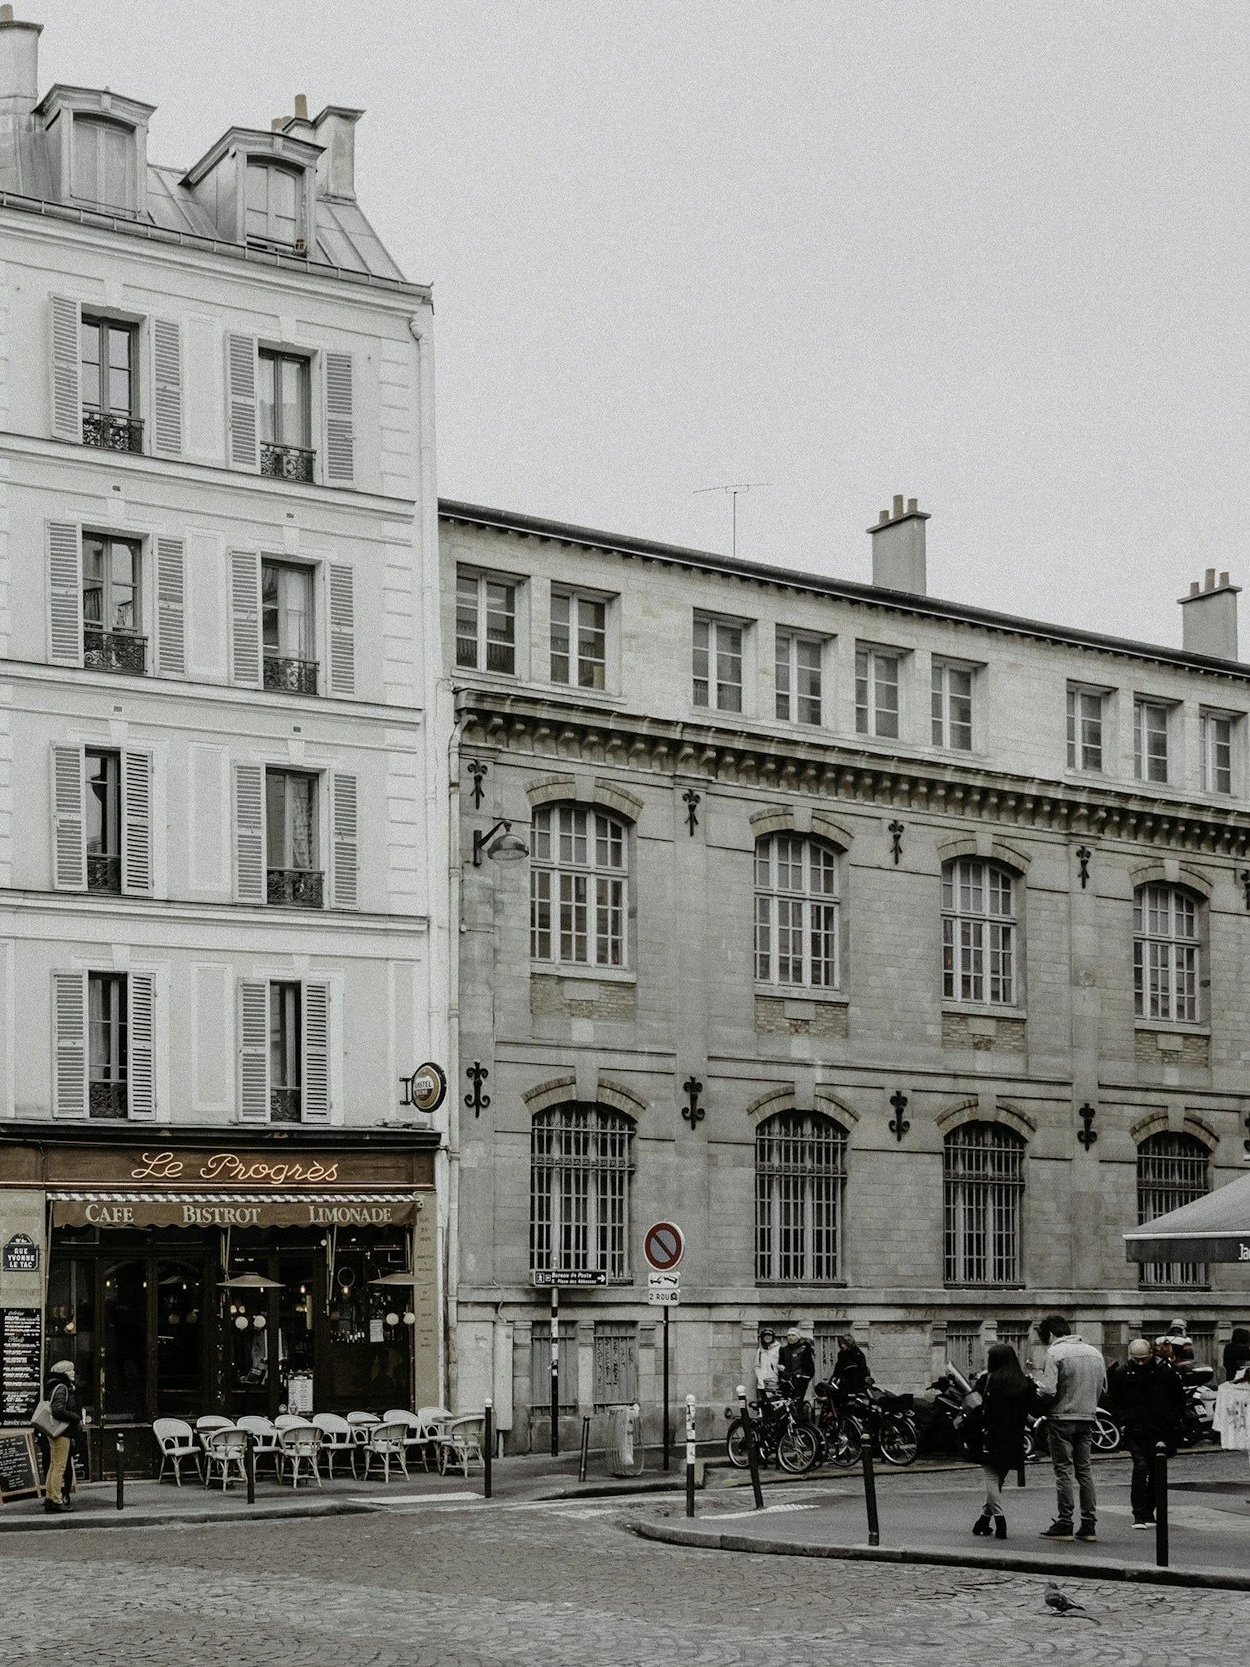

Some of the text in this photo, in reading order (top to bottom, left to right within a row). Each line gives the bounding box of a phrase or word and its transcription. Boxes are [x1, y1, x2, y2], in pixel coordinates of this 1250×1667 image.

[131, 1152, 339, 1185] Le Progrès
[85, 1203, 392, 1224] CAFE BISTROT LIMONADE
[14, 1247, 29, 1255] RUE
[1238, 1243, 1250, 1260] Ja
[7, 1254, 35, 1262] YVONNE
[656, 1292, 678, 1301] ROU
